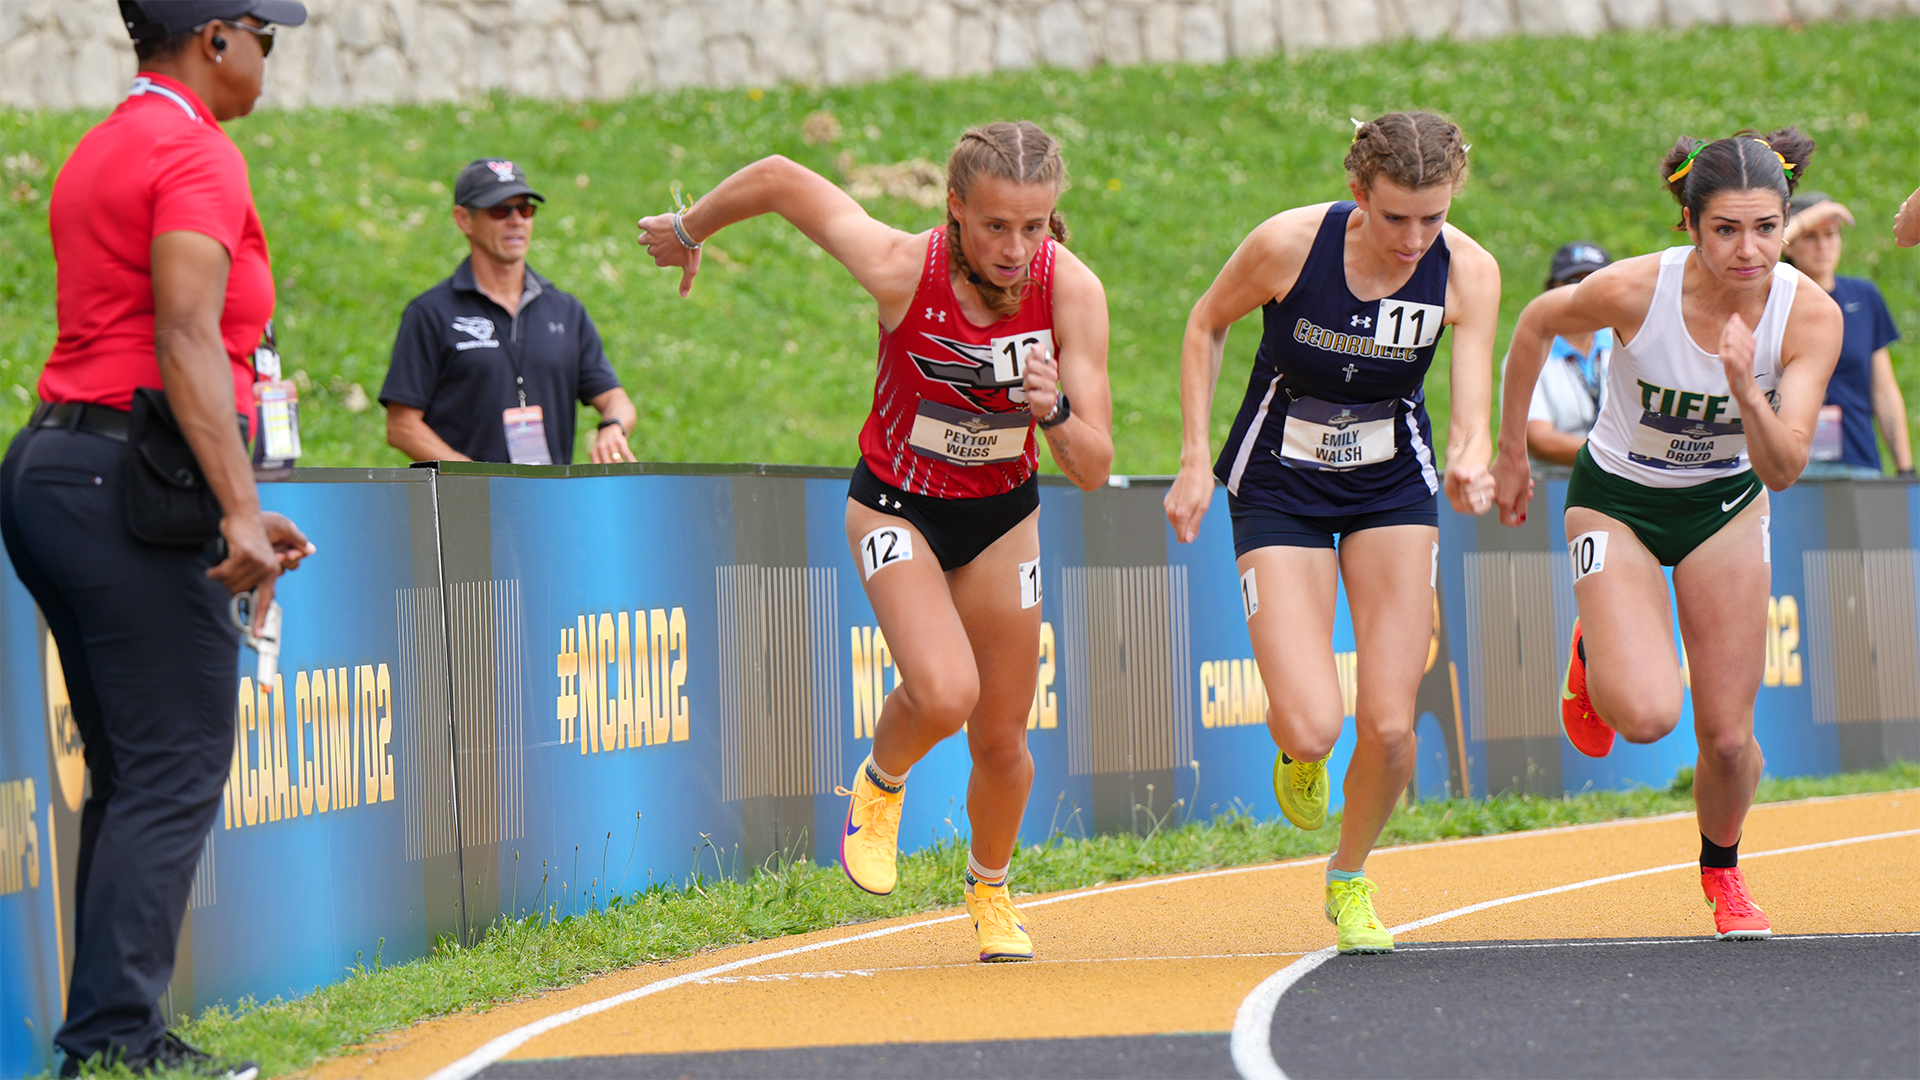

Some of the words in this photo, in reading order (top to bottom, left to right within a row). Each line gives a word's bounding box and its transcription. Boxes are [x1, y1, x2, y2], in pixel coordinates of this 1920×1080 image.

[1389, 306, 1425, 346] 11
[1637, 378, 1742, 424] TIFF
[944, 428, 998, 446] PEYTON
[1322, 429, 1360, 447] EMILY
[1670, 438, 1714, 452] OLIVIA
[946, 442, 990, 458] WEISS
[1315, 446, 1362, 463] WALSH
[1665, 449, 1712, 463] DROZD
[866, 530, 900, 570] 12
[1573, 536, 1595, 580] 10
[557, 606, 690, 756] #NCAAD2
